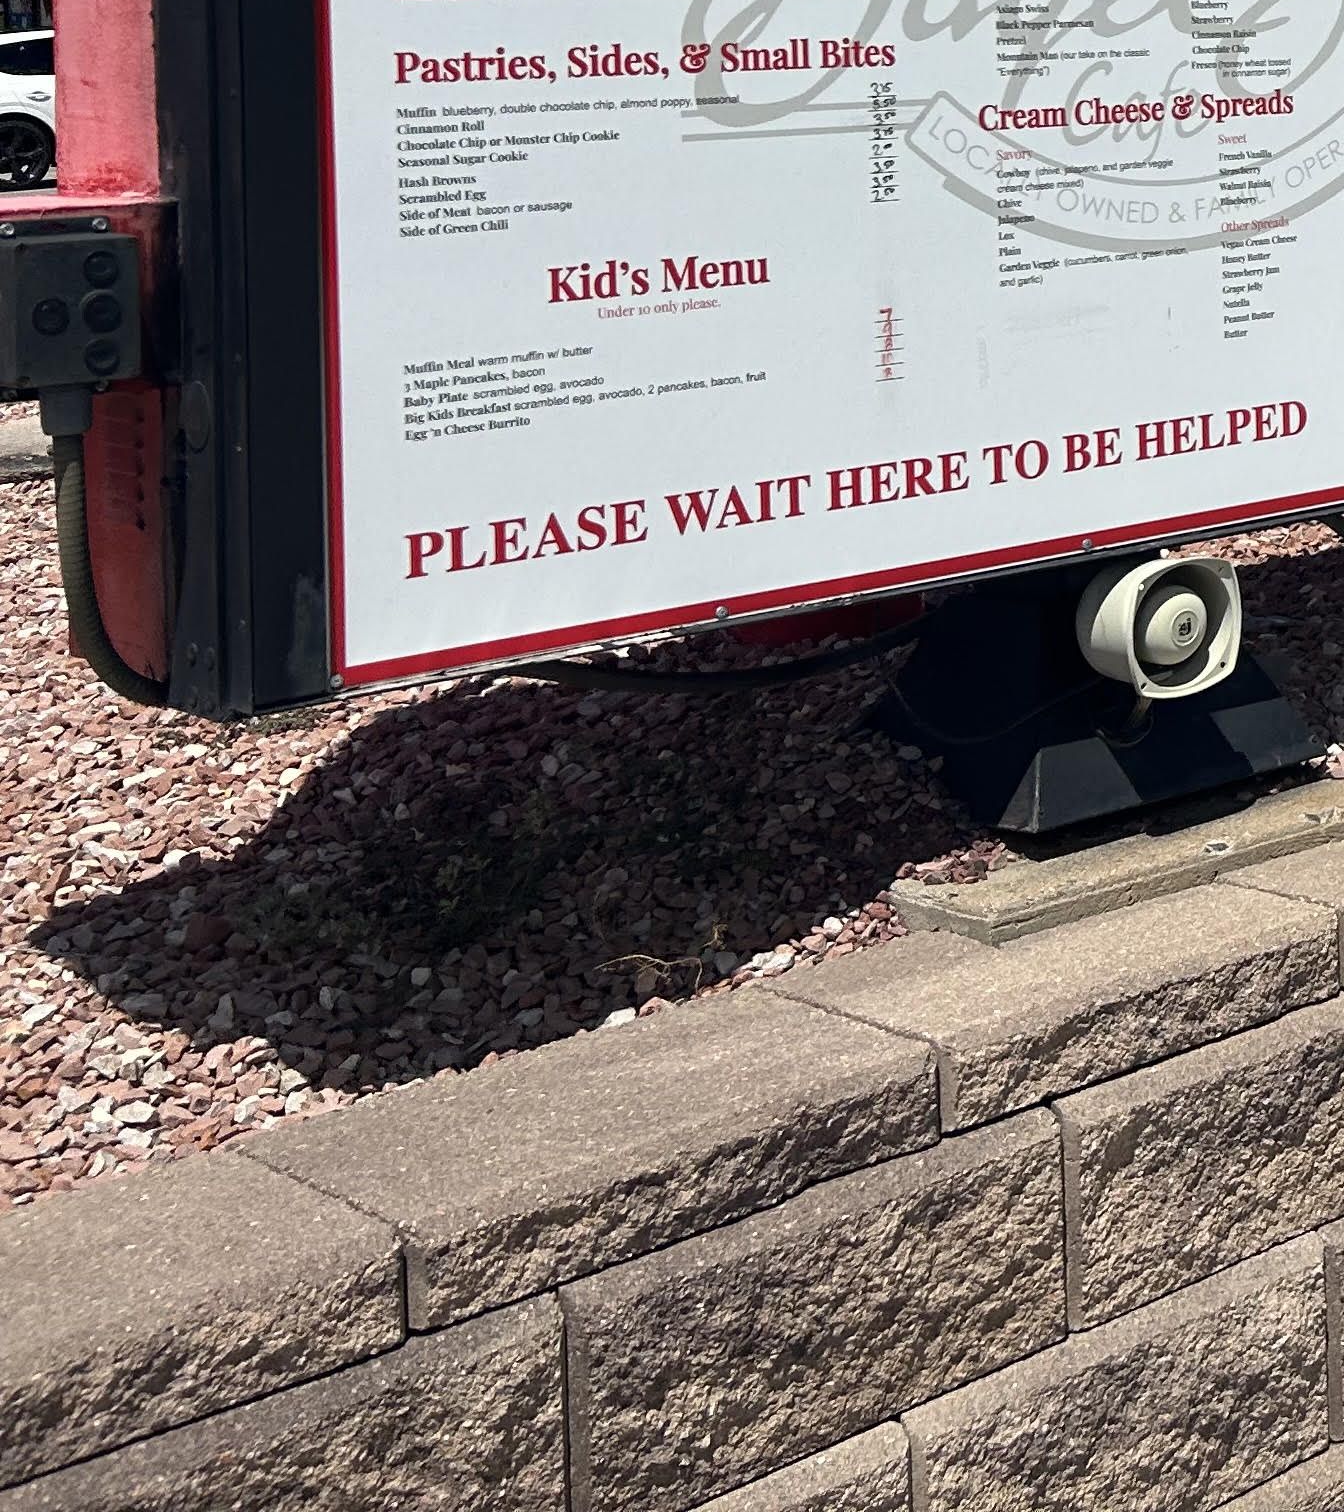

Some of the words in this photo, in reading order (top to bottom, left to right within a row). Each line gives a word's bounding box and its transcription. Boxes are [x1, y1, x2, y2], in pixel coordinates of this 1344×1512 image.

[393, 50, 557, 83] Pastries,
[567, 46, 669, 78] Sides,
[679, 43, 711, 73] &
[719, 38, 812, 72] Small
[818, 38, 896, 68] Bites
[395, 124, 459, 135] Cinnamon
[461, 120, 485, 132] Roll
[977, 105, 1070, 135] Cream
[1074, 99, 1168, 126] Cheese
[1171, 94, 1195, 120] &
[1198, 90, 1294, 123] Spreads
[398, 176, 429, 188] Hash
[431, 175, 477, 186] Browns
[1056, 189, 1159, 224] OWNED
[1168, 202, 1187, 224] &
[399, 225, 426, 237] Side
[427, 223, 442, 236] of
[442, 223, 479, 234] Green
[547, 261, 650, 302] Kid's
[660, 256, 771, 292] Menu
[597, 305, 635, 319] Under
[653, 300, 680, 314] only
[405, 500, 649, 578] PLEASE
[663, 476, 811, 532] WAIT
[825, 452, 970, 509] HERE
[982, 440, 1049, 484] TO
[1062, 428, 1123, 472] BE
[1134, 402, 1307, 459] HELPED
